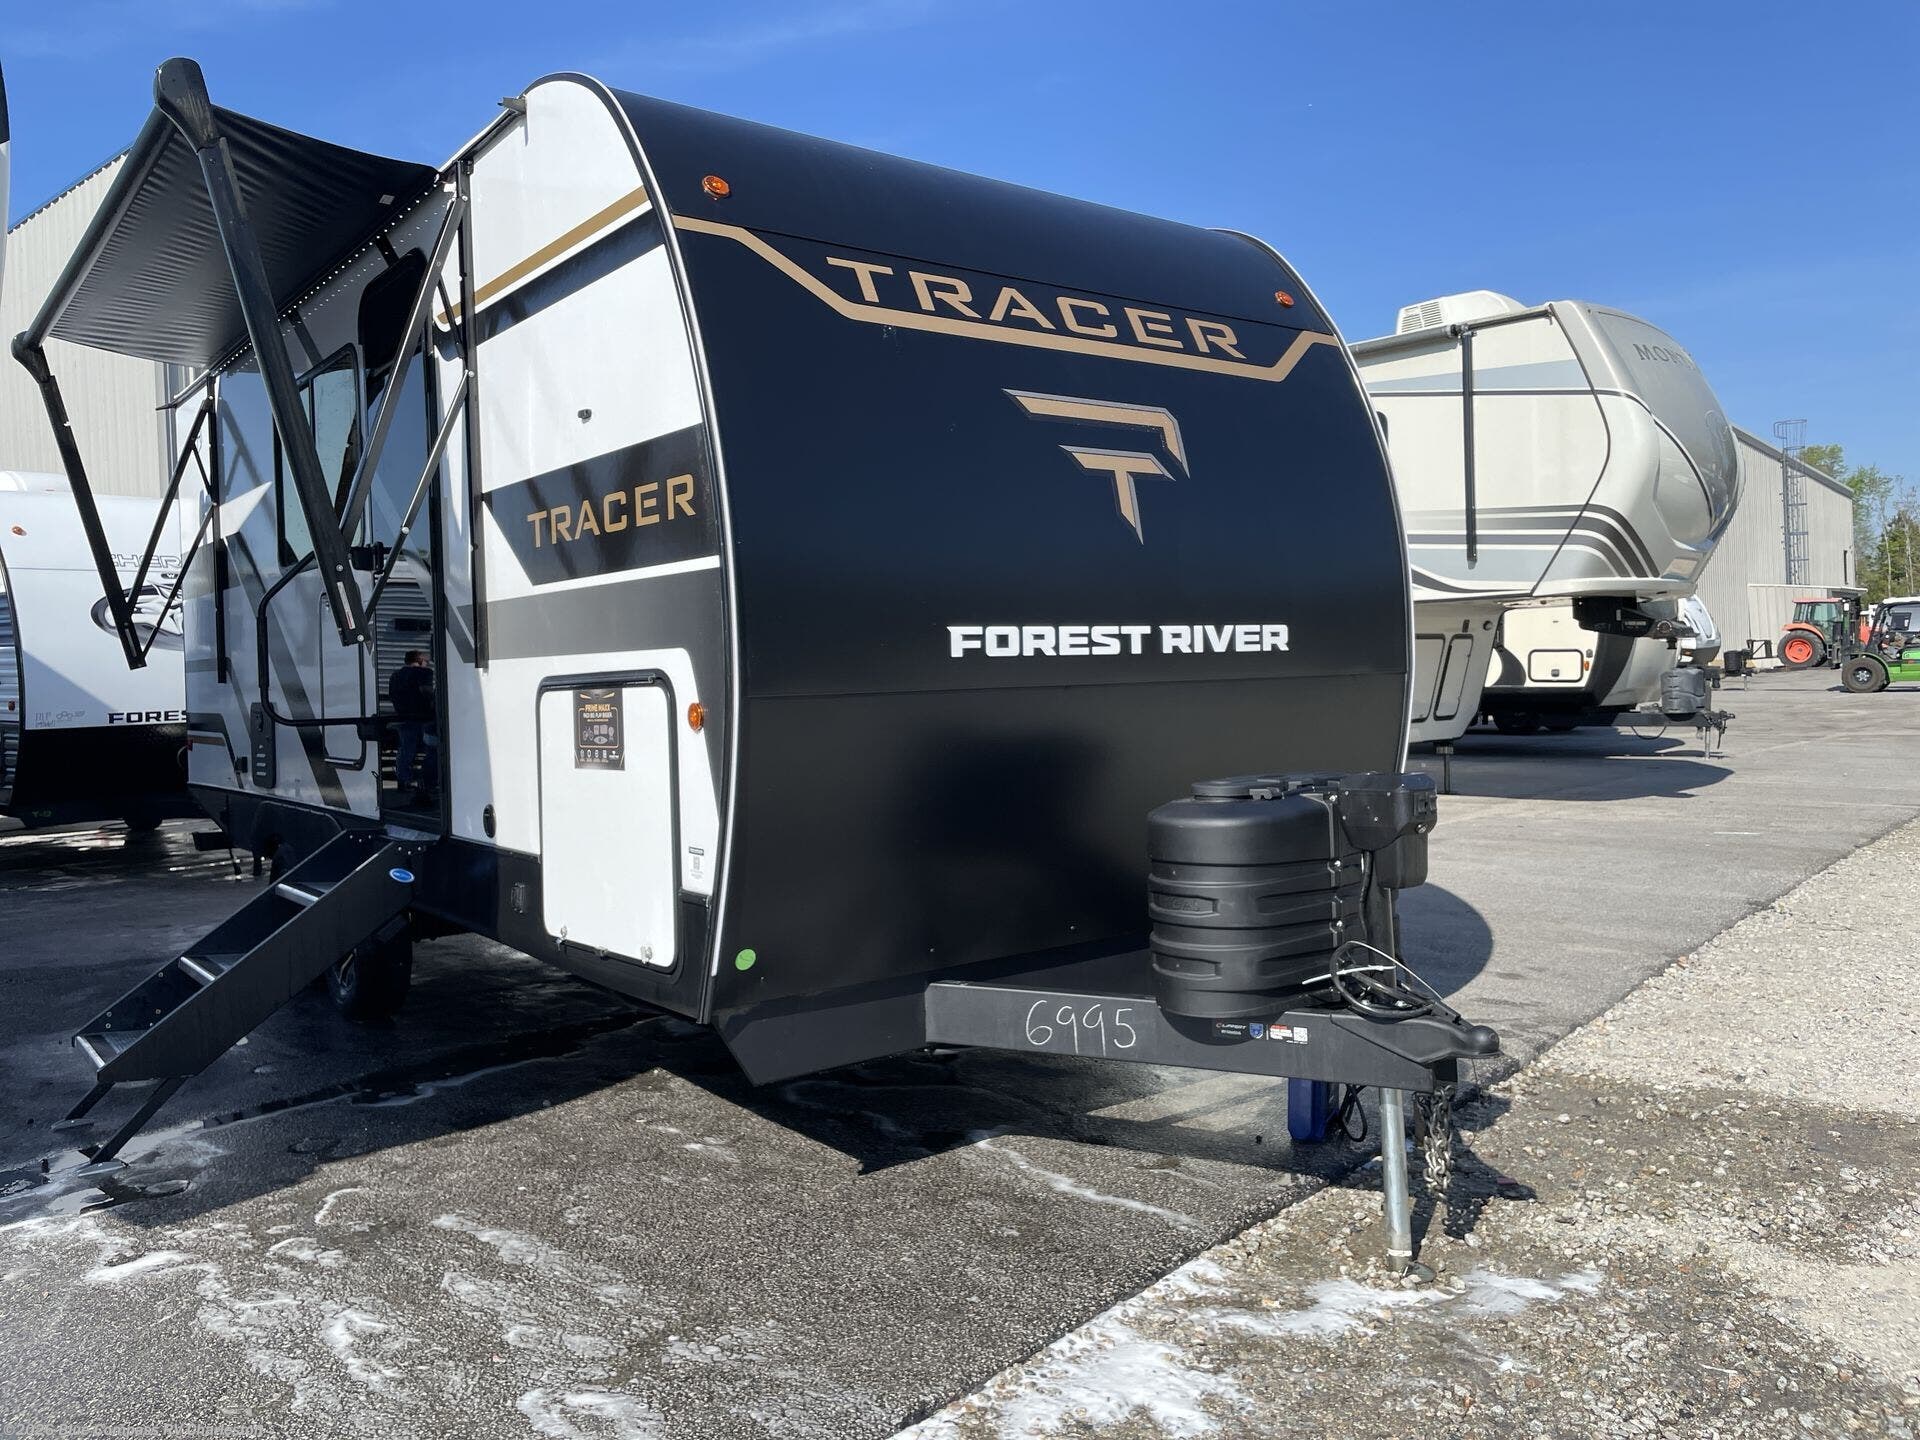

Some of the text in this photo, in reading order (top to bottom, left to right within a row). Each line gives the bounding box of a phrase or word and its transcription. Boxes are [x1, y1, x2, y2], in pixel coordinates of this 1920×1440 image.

[826, 256, 1247, 360] TRACER
[527, 473, 697, 549] TRACER
[947, 624, 1290, 658] FOREST RIVER
[108, 710, 187, 724] FORE
[1025, 999, 1137, 1057] 6995
